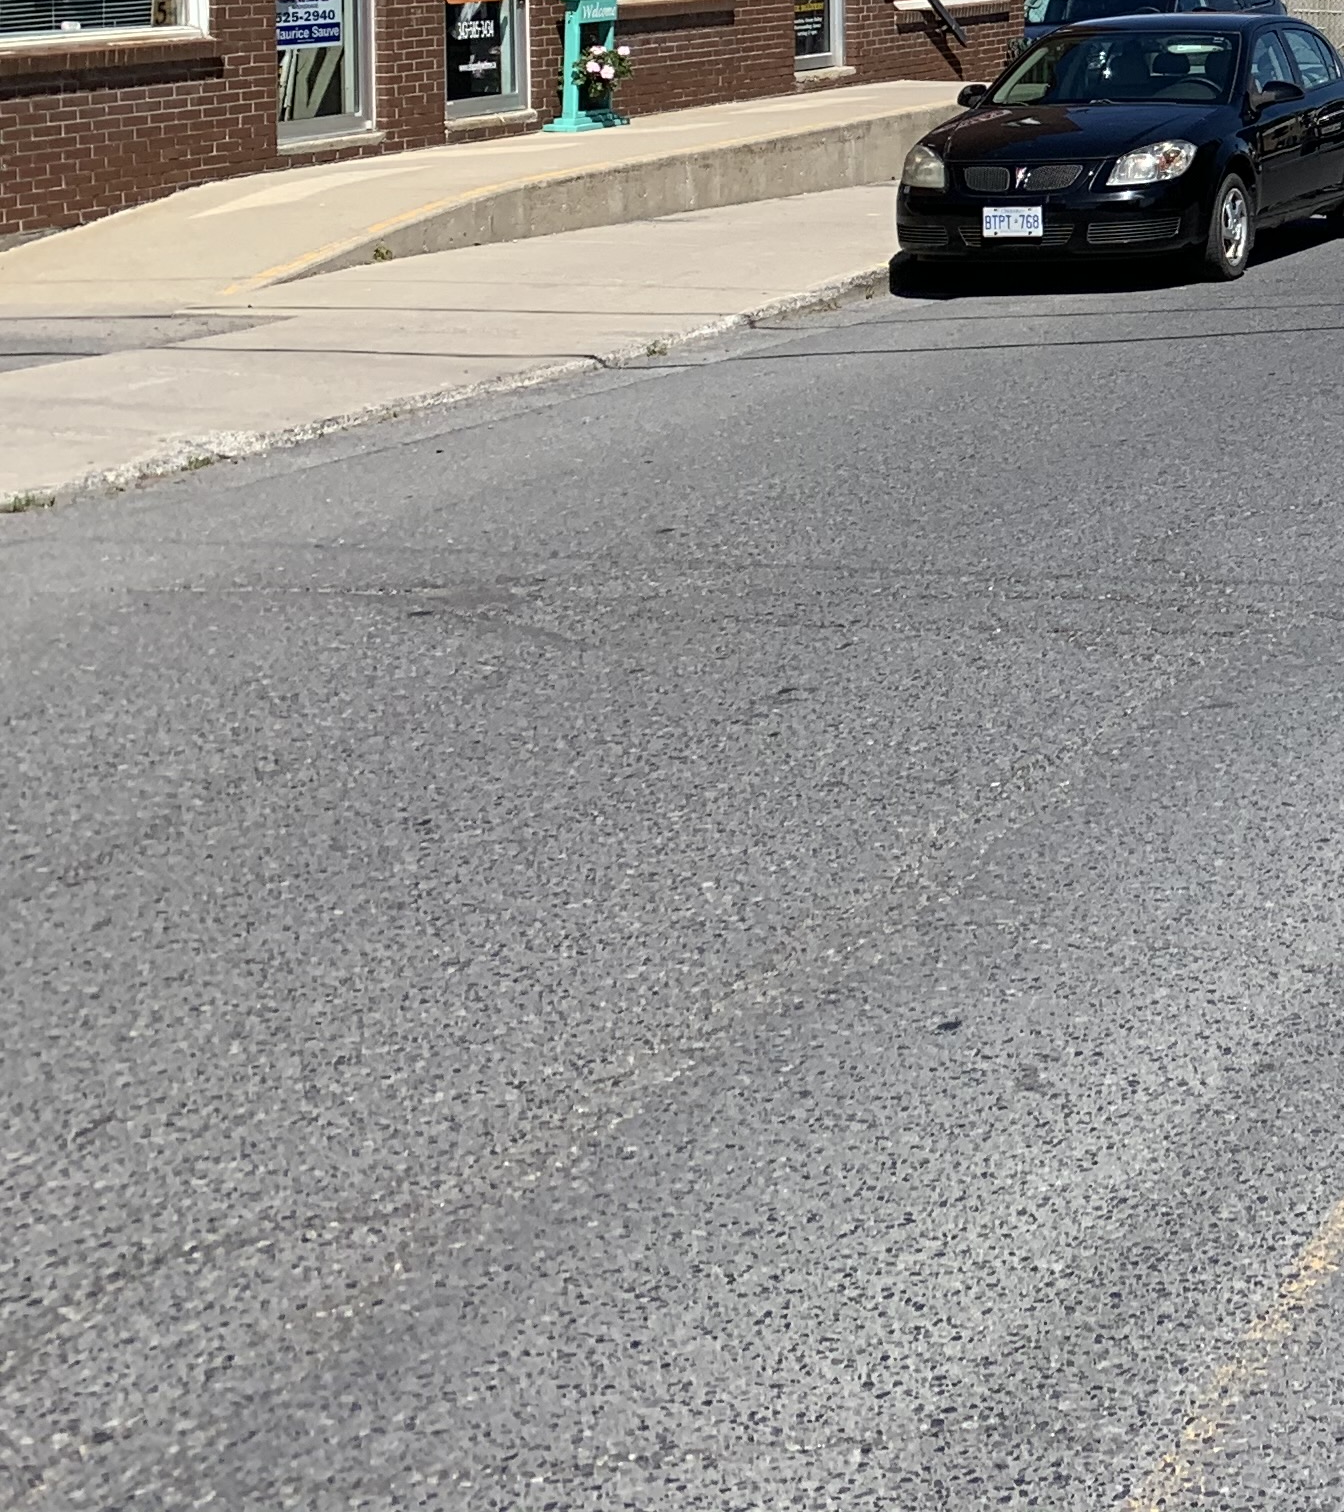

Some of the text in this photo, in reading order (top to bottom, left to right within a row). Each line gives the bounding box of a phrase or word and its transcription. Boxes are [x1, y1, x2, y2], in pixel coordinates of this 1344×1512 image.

[312, 26, 340, 39] Sauve
[984, 214, 1040, 230] BTPT 768
